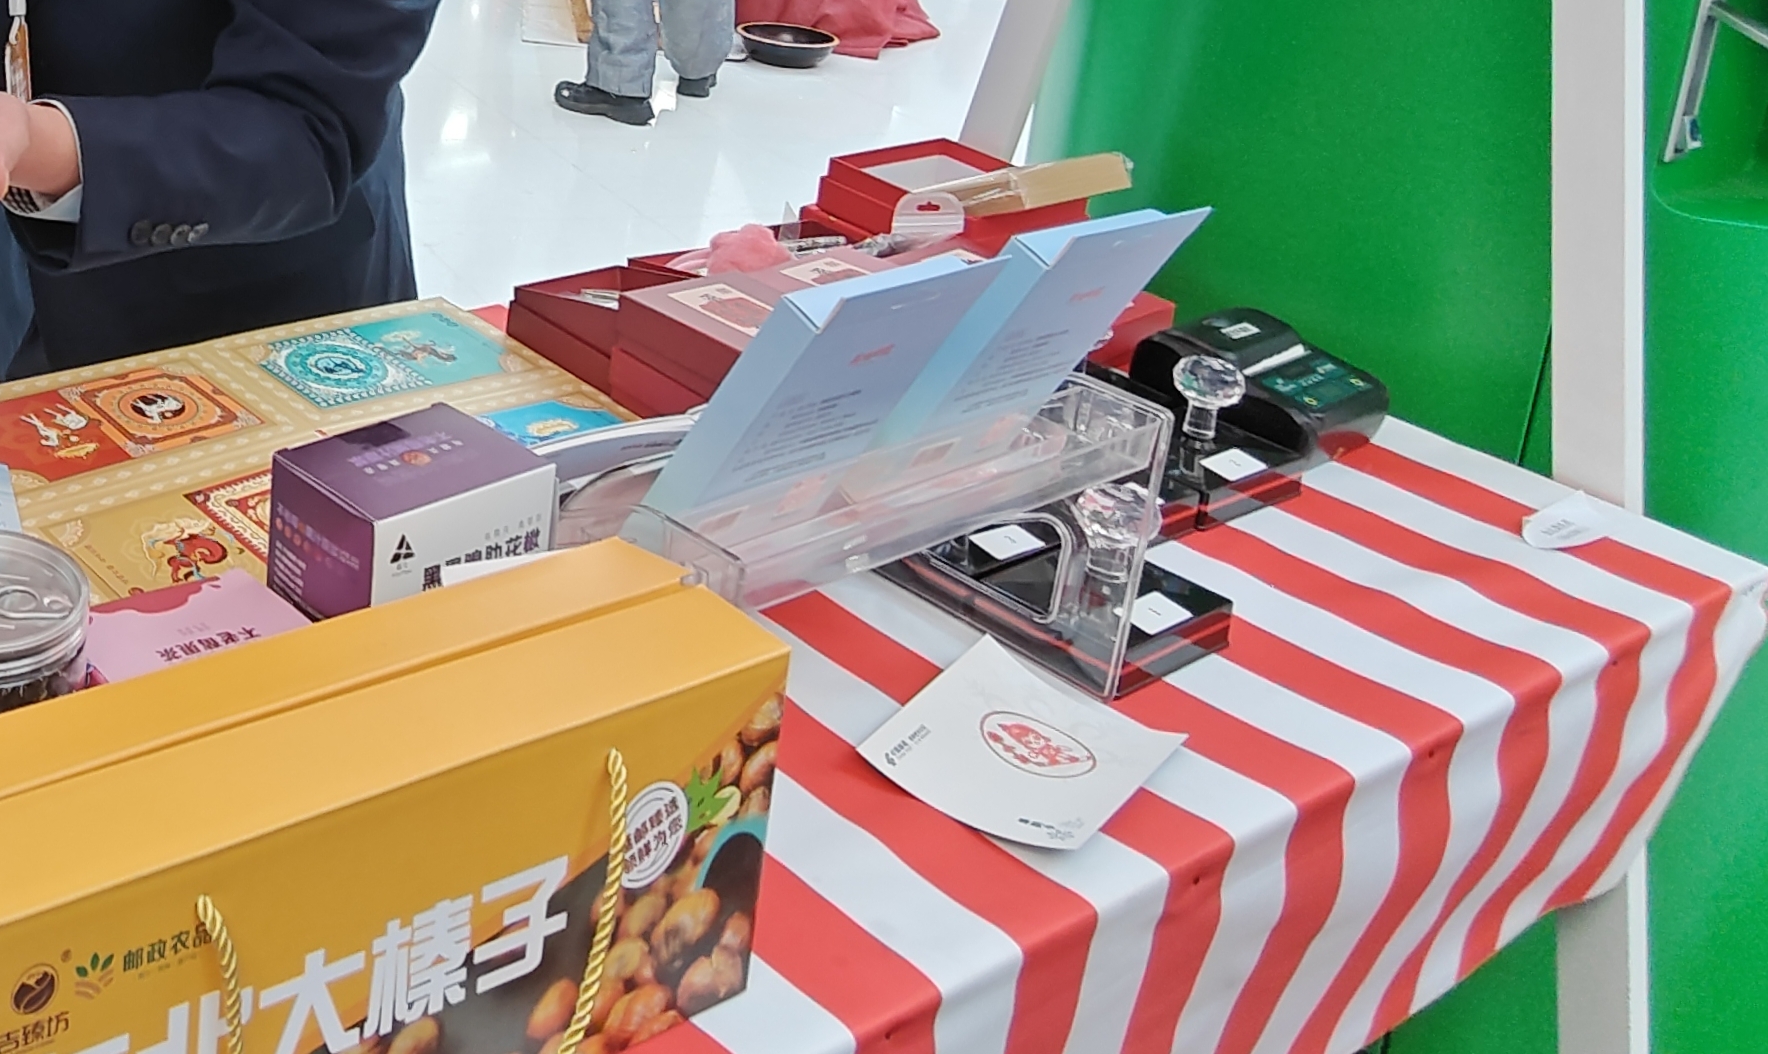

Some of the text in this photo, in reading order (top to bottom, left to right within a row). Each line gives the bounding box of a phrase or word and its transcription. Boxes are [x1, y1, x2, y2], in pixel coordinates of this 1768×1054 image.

[64, 854, 569, 1054] 北大榛子
[122, 922, 215, 973] 邮政农品
